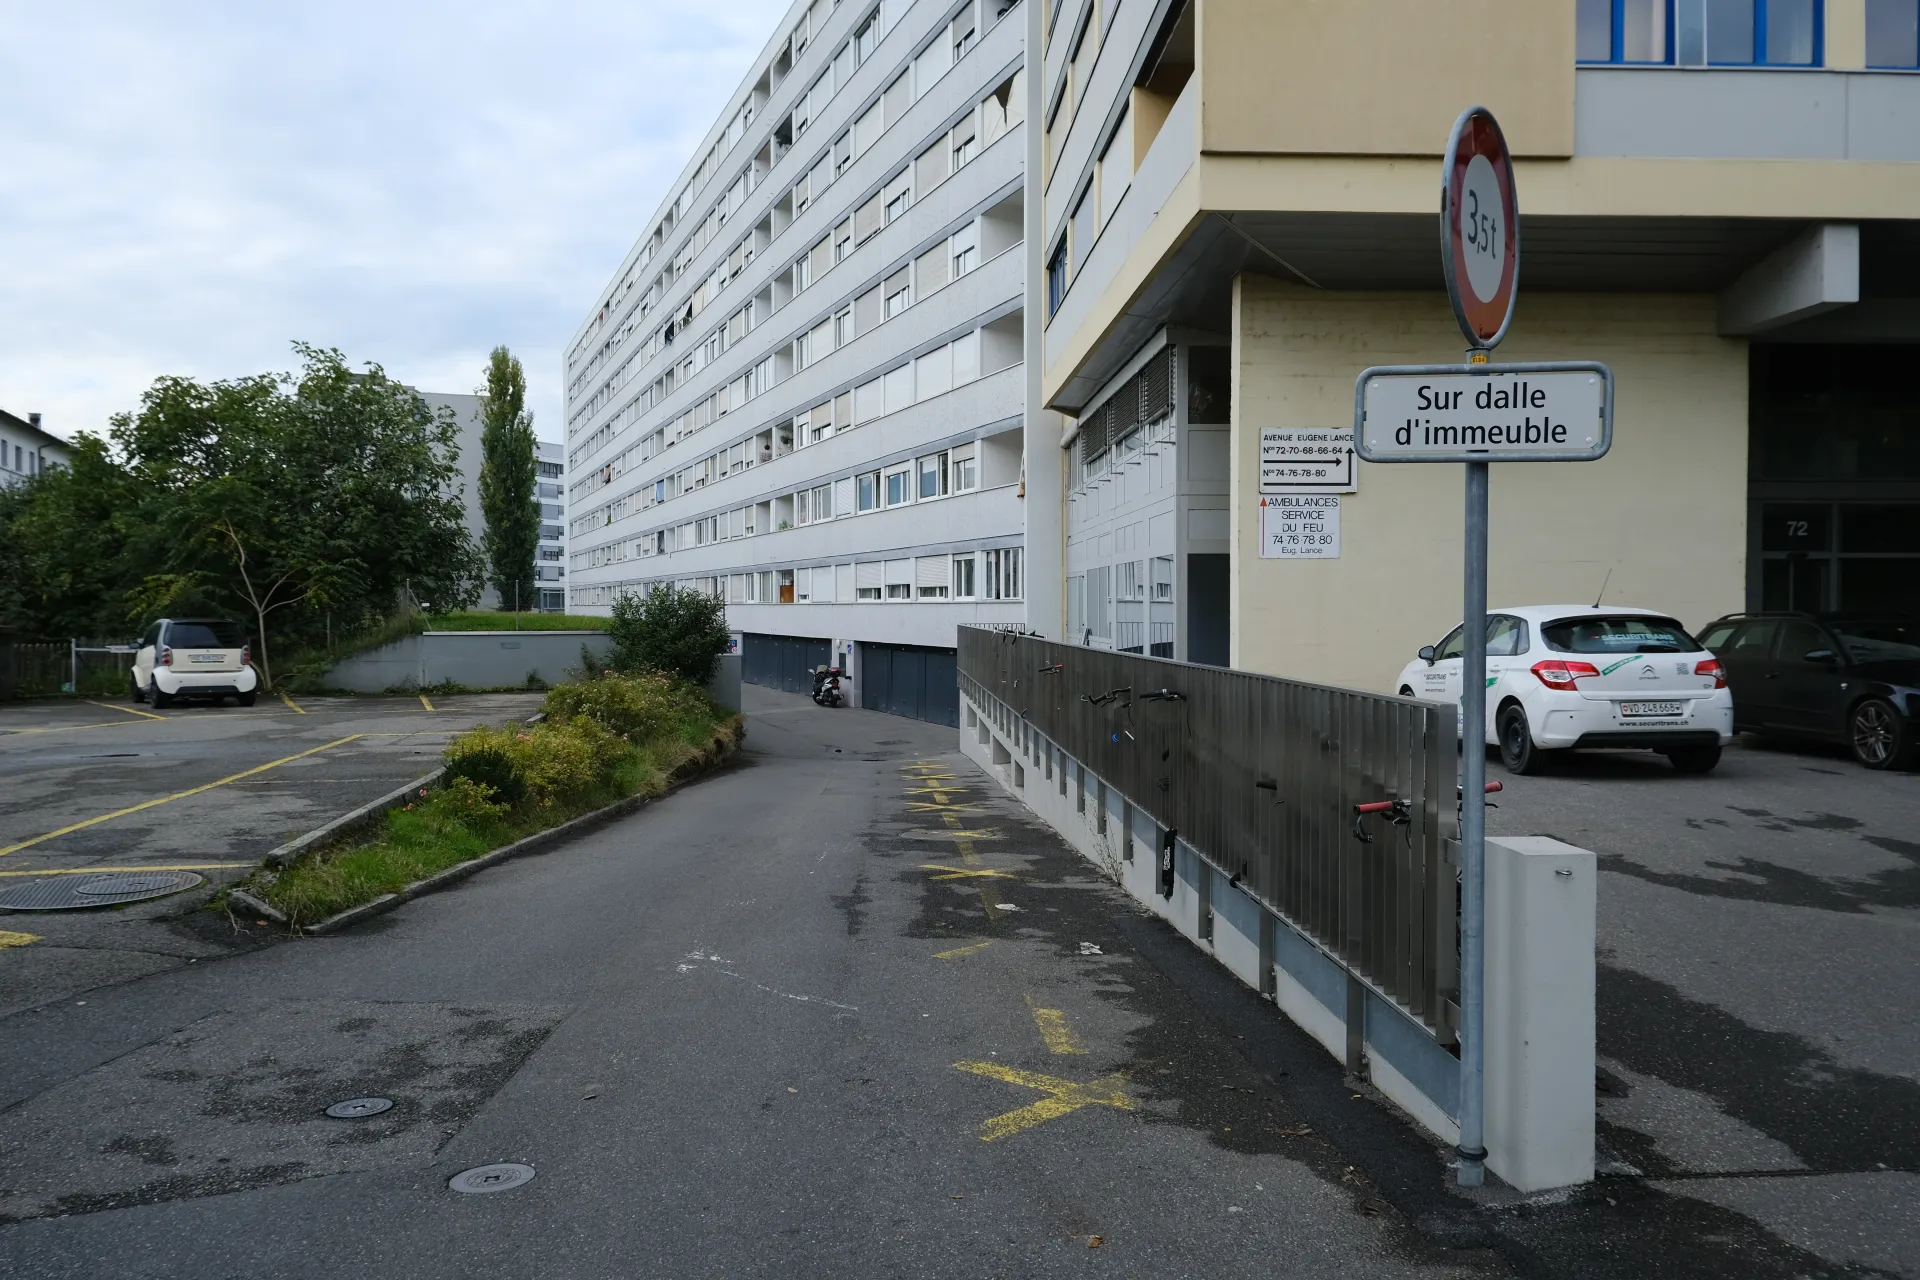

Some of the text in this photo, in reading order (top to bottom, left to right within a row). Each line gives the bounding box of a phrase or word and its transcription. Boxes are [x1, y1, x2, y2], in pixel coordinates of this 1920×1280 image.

[1417, 381, 1546, 411] Sur dalle
[1395, 416, 1567, 446] d'immeuble
[1263, 434, 1354, 442] AVENUE EUGENE LANCE
[1267, 497, 1339, 507] AMBULANCES
[1281, 510, 1325, 520] SERVICE
[1282, 523, 1324, 533] DU FEU
[1787, 521, 1808, 536] 72
[1281, 546, 1323, 555] Eug. Lance
